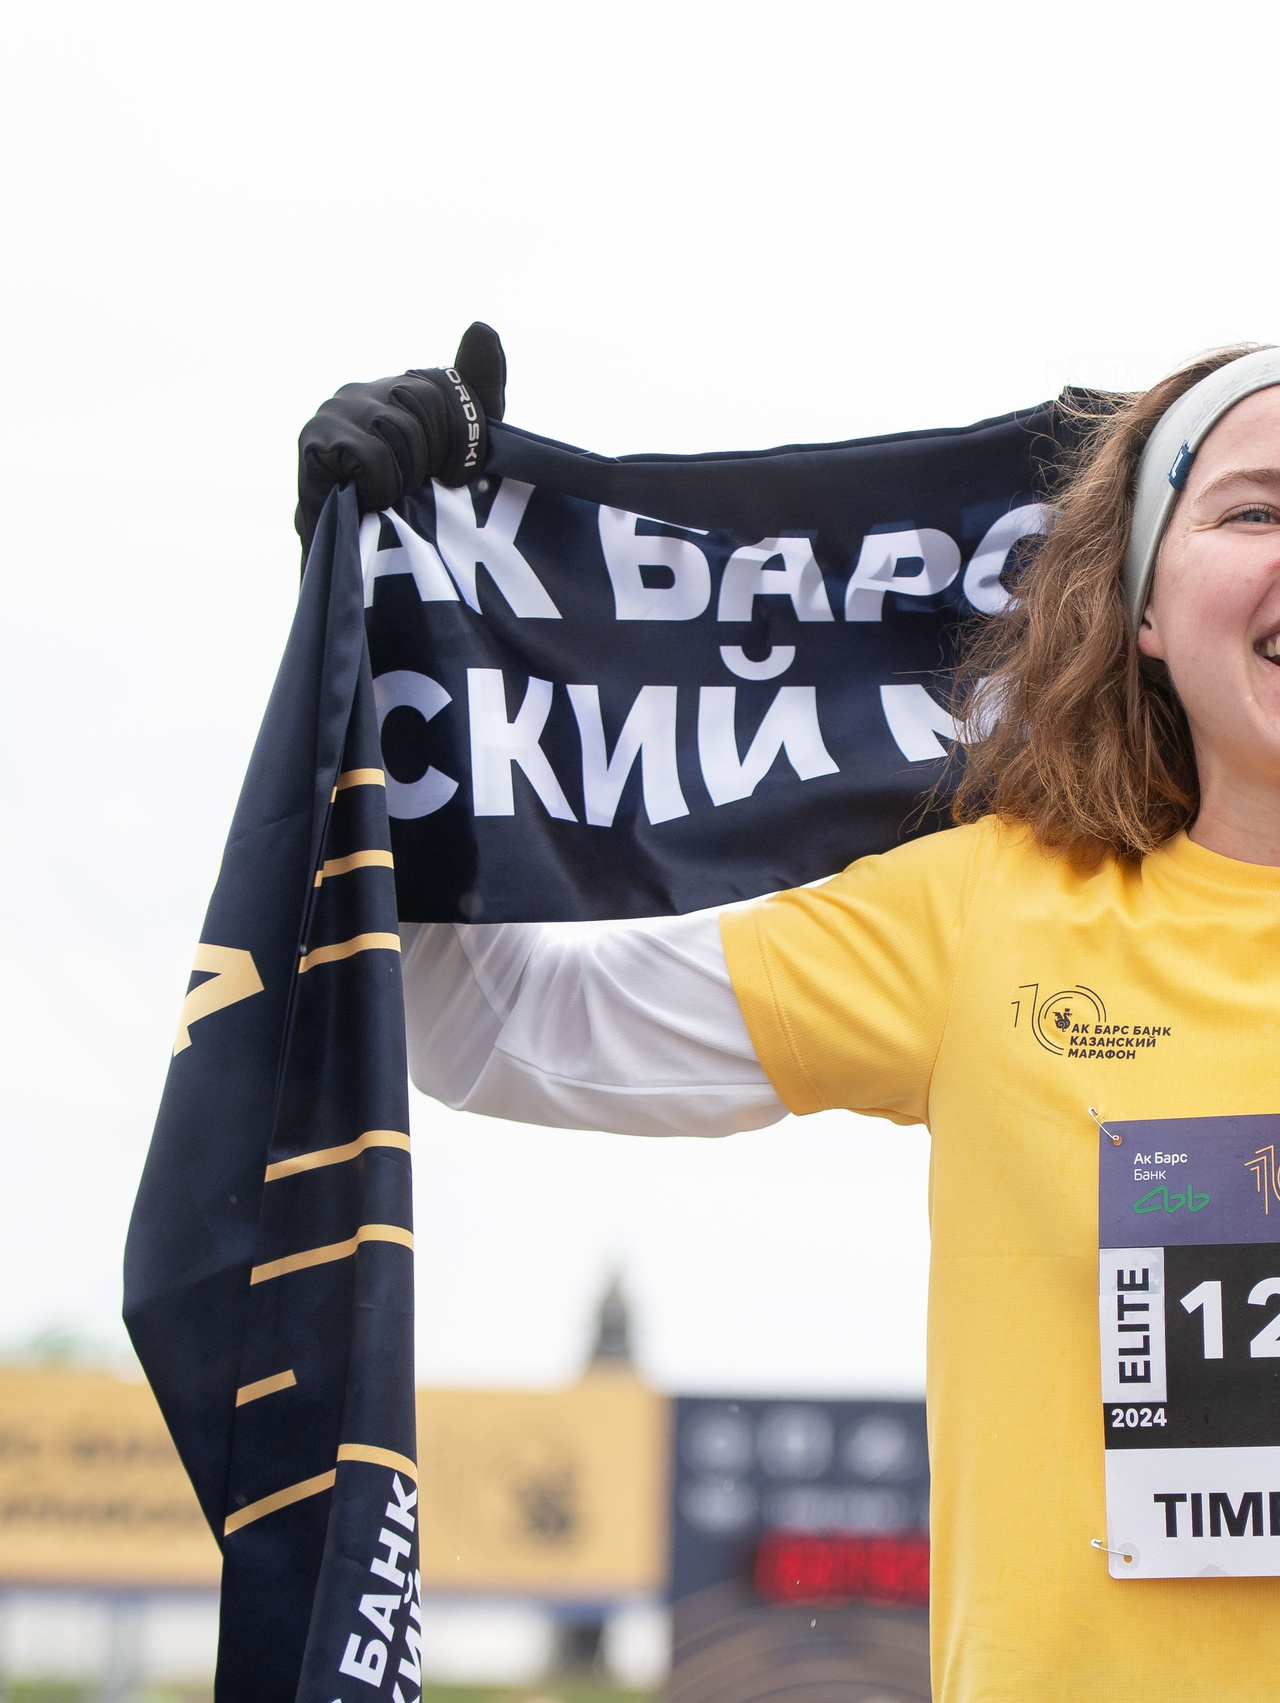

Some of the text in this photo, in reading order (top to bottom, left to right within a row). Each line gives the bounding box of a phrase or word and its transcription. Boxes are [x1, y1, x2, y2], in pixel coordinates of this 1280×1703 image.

[445, 368, 480, 467] ORDSKI
[361, 478, 562, 620] АК
[1071, 1024, 1172, 1037] АК БАРС БАНК
[1070, 1035, 1157, 1049] КАЗАНСКИЙ
[1067, 1048, 1136, 1060] МАРАФОН
[1133, 1151, 1188, 1166] Ак Барс
[1134, 1168, 1167, 1181] Банк
[1117, 1267, 1152, 1384] ELITE
[1111, 1407, 1168, 1428] 2024
[339, 1472, 418, 1688] БАНК
